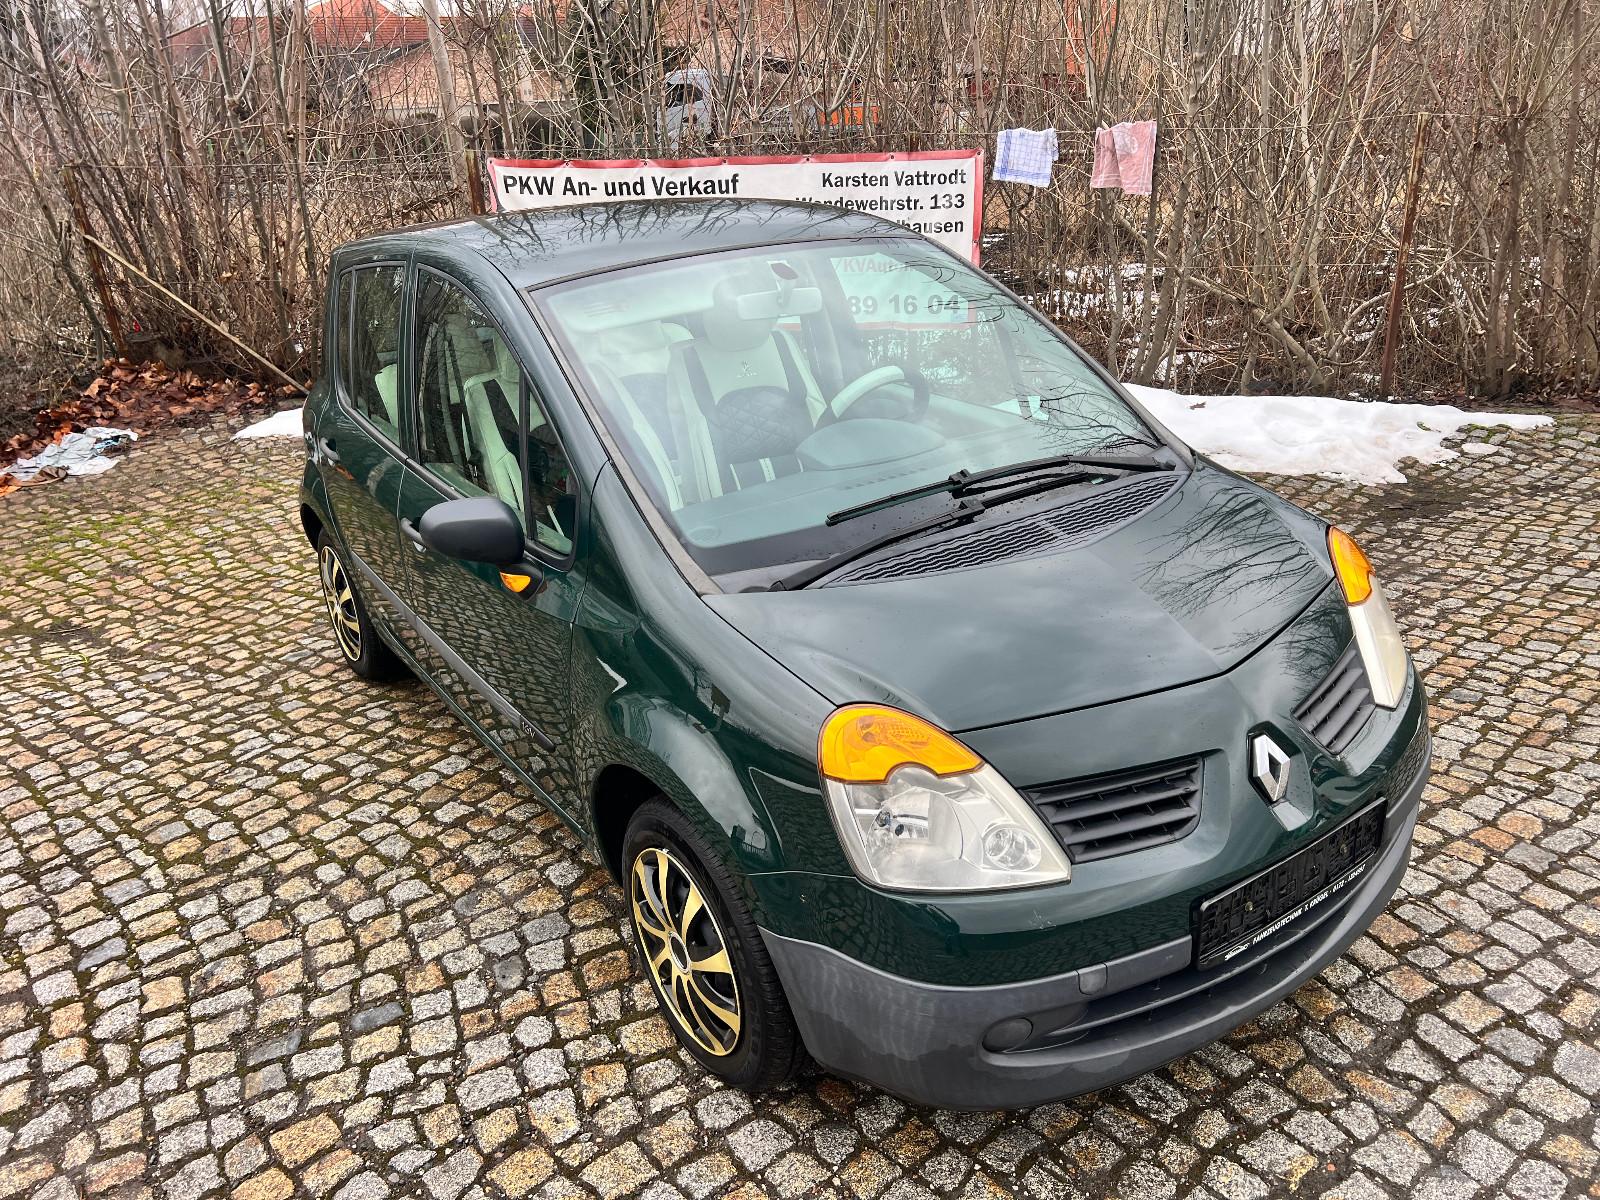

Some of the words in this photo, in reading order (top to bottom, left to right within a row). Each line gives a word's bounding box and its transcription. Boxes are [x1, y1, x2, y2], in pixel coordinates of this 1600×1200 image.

[503, 175, 554, 195] PKW
[562, 176, 597, 195] An-
[604, 176, 645, 196] und
[651, 173, 740, 196] Verkauf
[822, 172, 888, 187] Karsten
[895, 169, 966, 186] Vattrodt
[795, 196, 923, 211] dewehrstr.
[929, 193, 965, 209] 133
[888, 294, 918, 315] 16
[927, 294, 960, 315] 04
